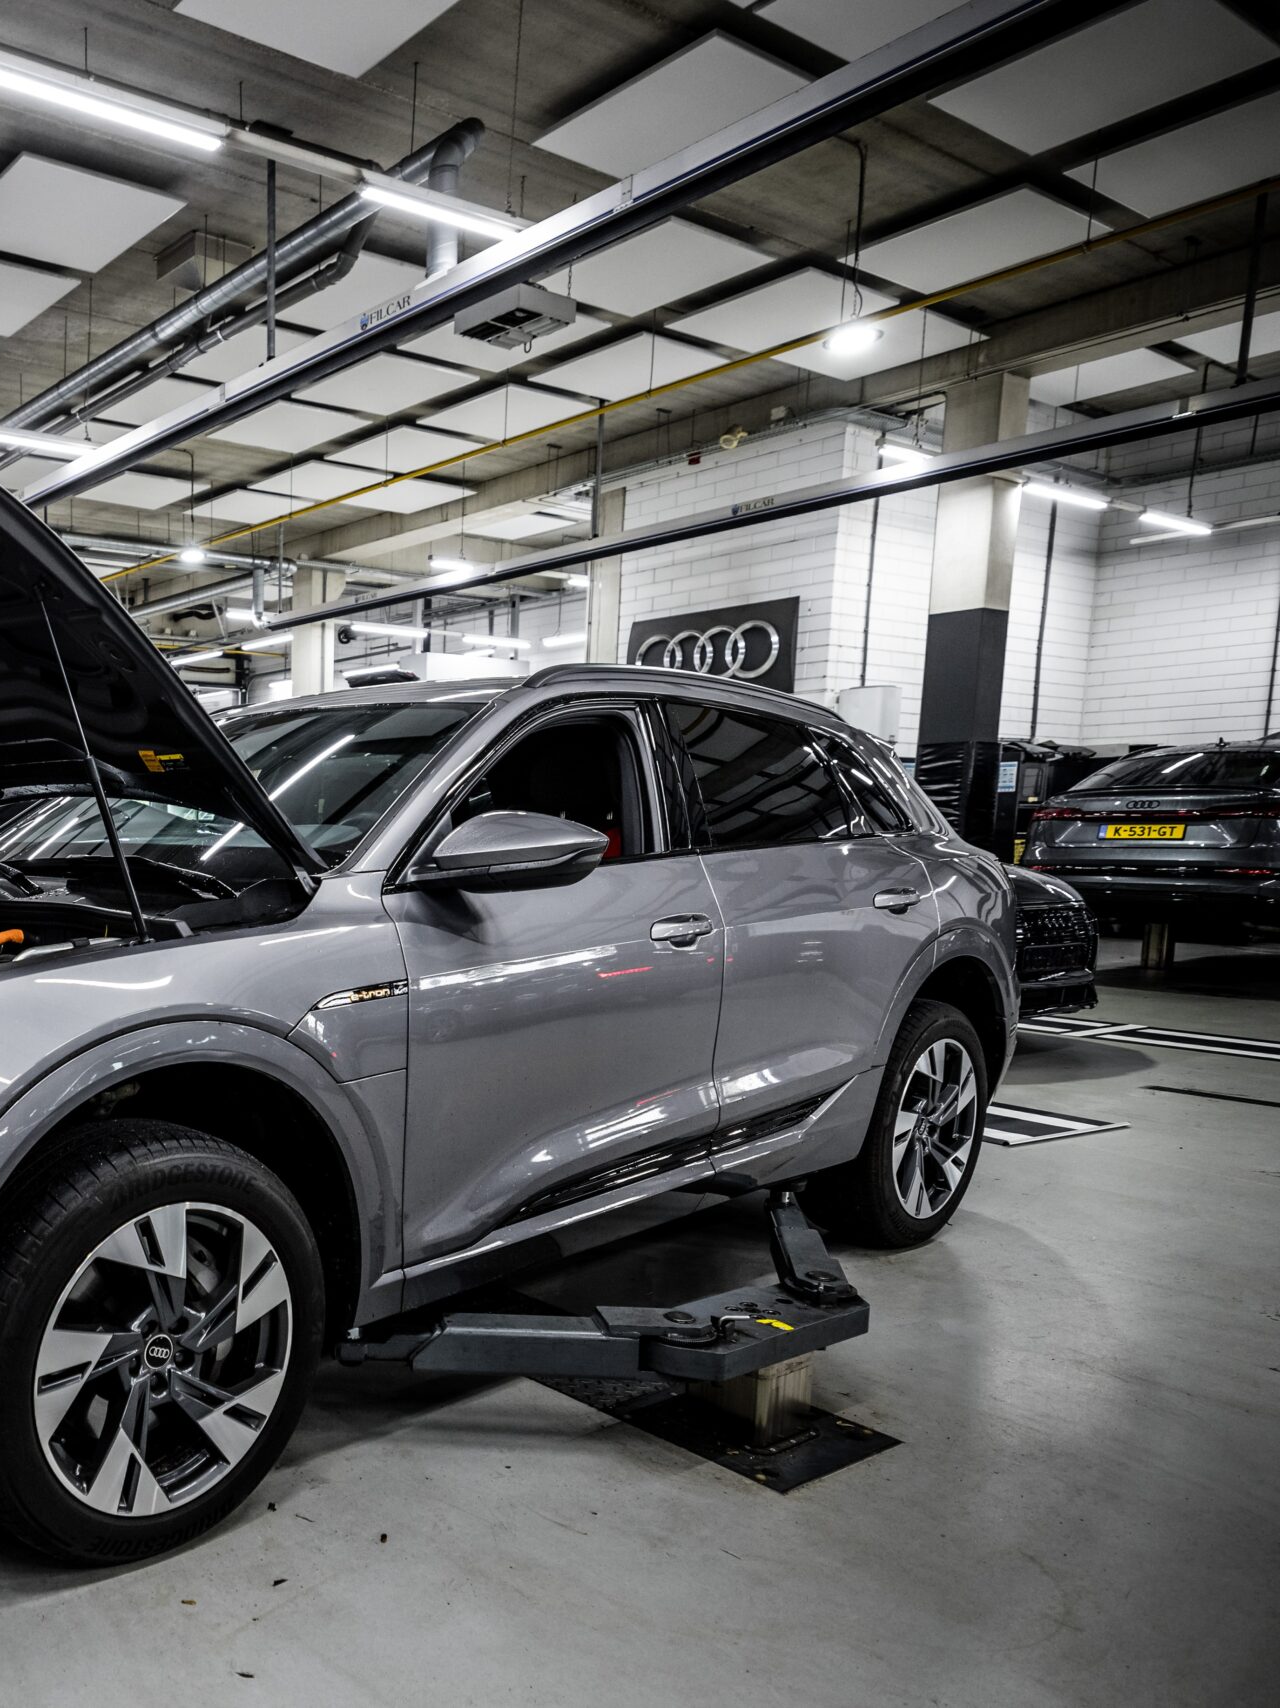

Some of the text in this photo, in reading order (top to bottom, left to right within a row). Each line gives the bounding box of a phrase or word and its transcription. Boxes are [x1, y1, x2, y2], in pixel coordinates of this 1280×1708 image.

[370, 295, 411, 325] FILCAR
[1113, 826, 1177, 837] K-531-GT
[350, 988, 391, 1001] e-tron
